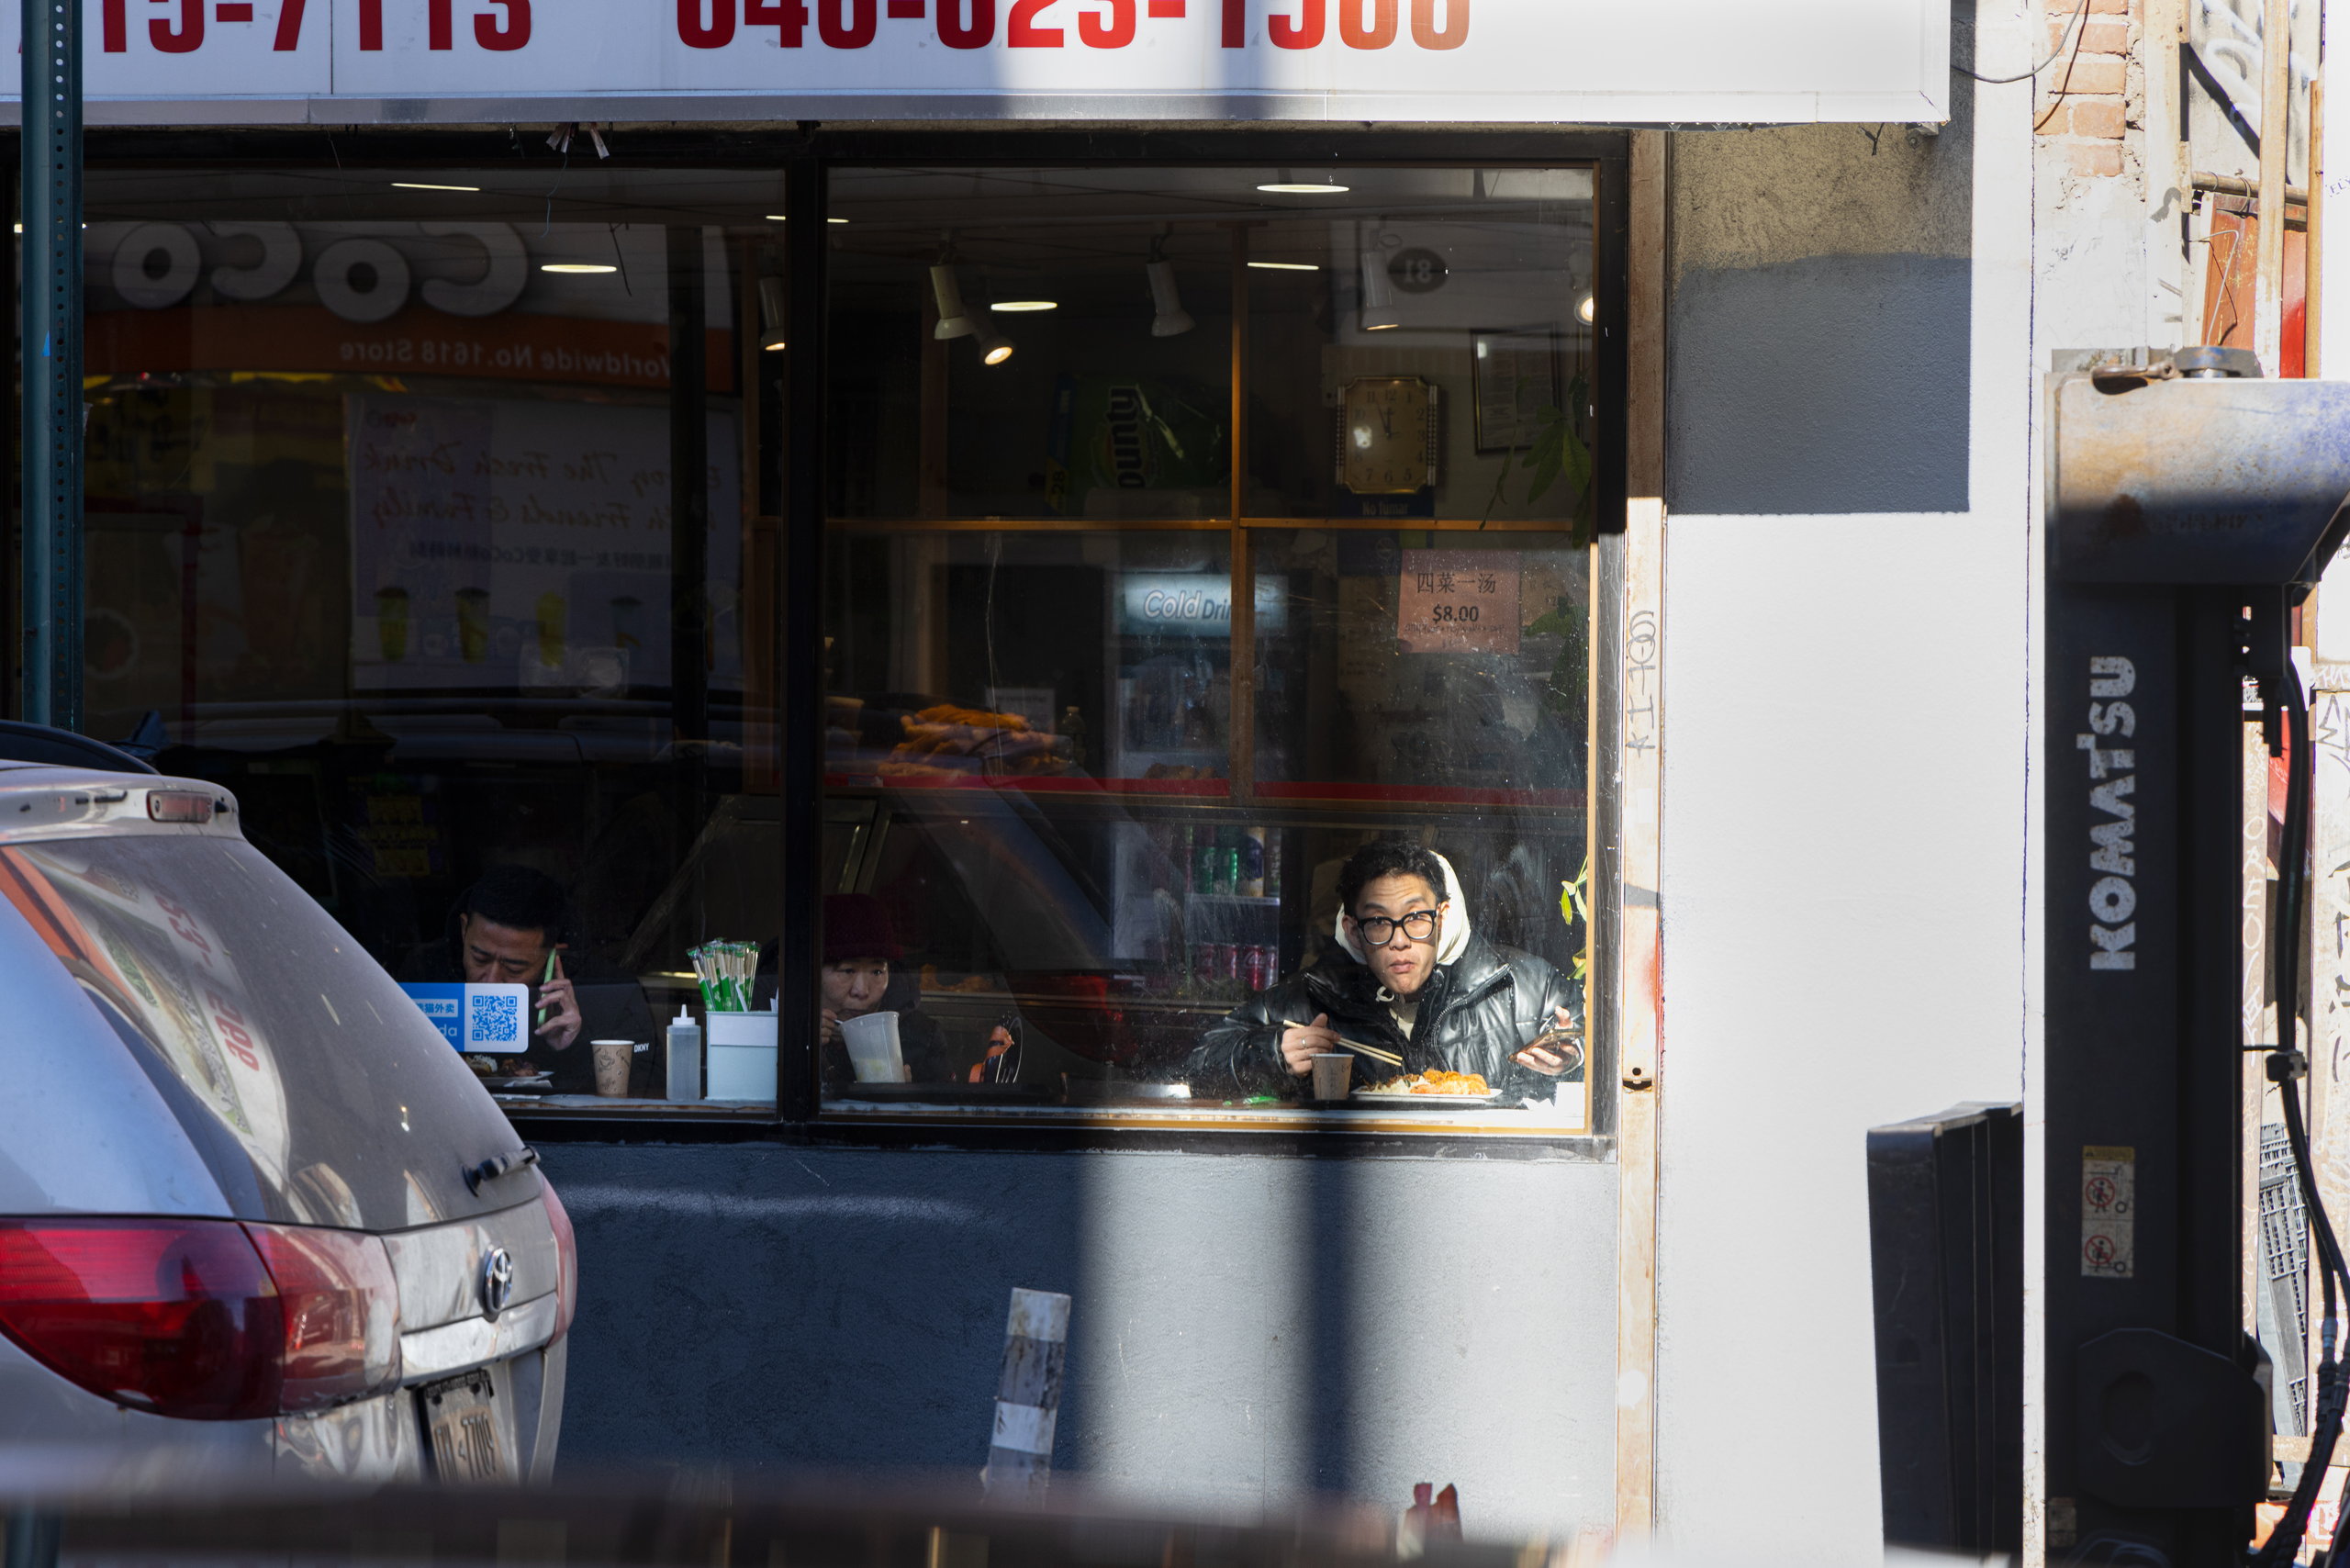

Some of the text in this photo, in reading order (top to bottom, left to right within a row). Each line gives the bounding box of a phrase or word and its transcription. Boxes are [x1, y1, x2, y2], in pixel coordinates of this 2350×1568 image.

[1106, 388, 1146, 487] ounty
[1416, 572, 1496, 594] 四菜一汤
[1144, 589, 1202, 620] Cold
[1432, 604, 1479, 624] $8.00
[2076, 655, 2137, 970] KOMATSU
[633, 1042, 649, 1054] DKNY
